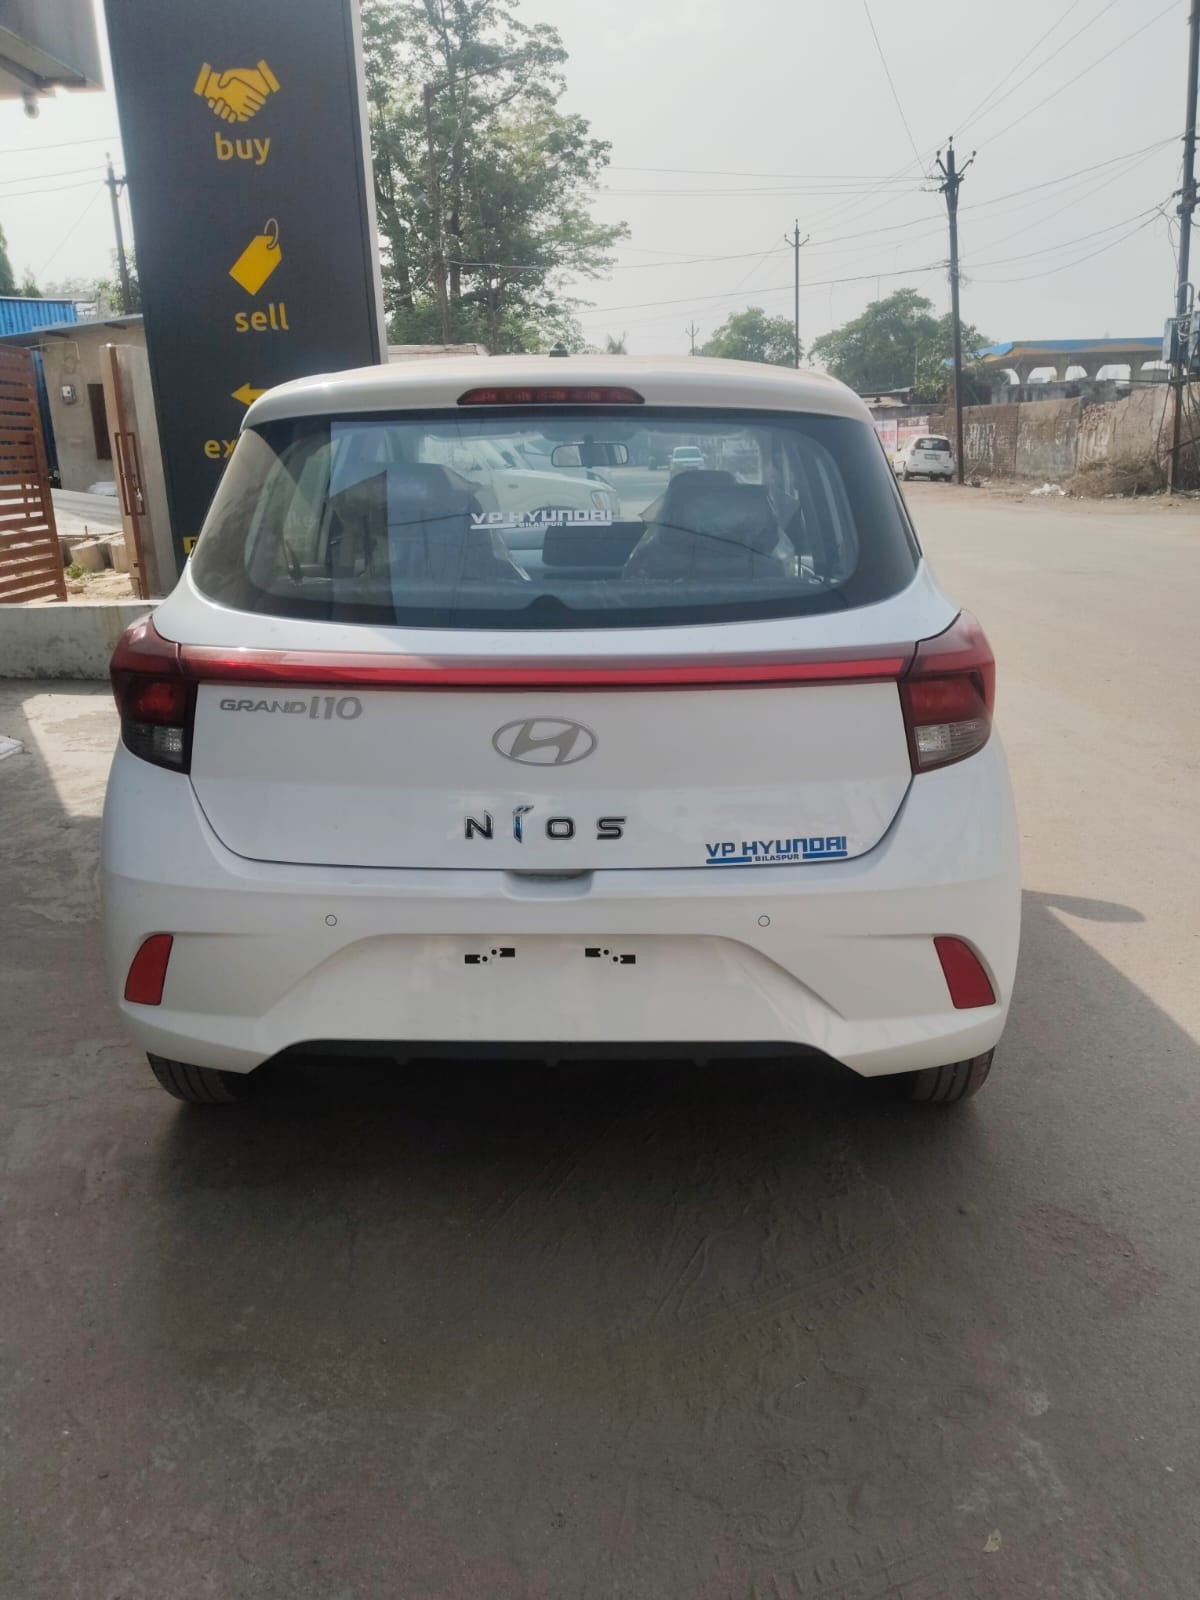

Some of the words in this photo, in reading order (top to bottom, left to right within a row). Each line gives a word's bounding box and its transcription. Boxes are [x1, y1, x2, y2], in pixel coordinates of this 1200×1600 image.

[215, 131, 271, 166] buy
[234, 302, 290, 333] sell
[471, 512, 504, 524] VP
[508, 509, 613, 523] HYUNDAI
[220, 699, 307, 714] GRAND
[705, 842, 736, 857] VP
[741, 836, 847, 856] HYUNDAI
[754, 853, 800, 862] BILASPUR
